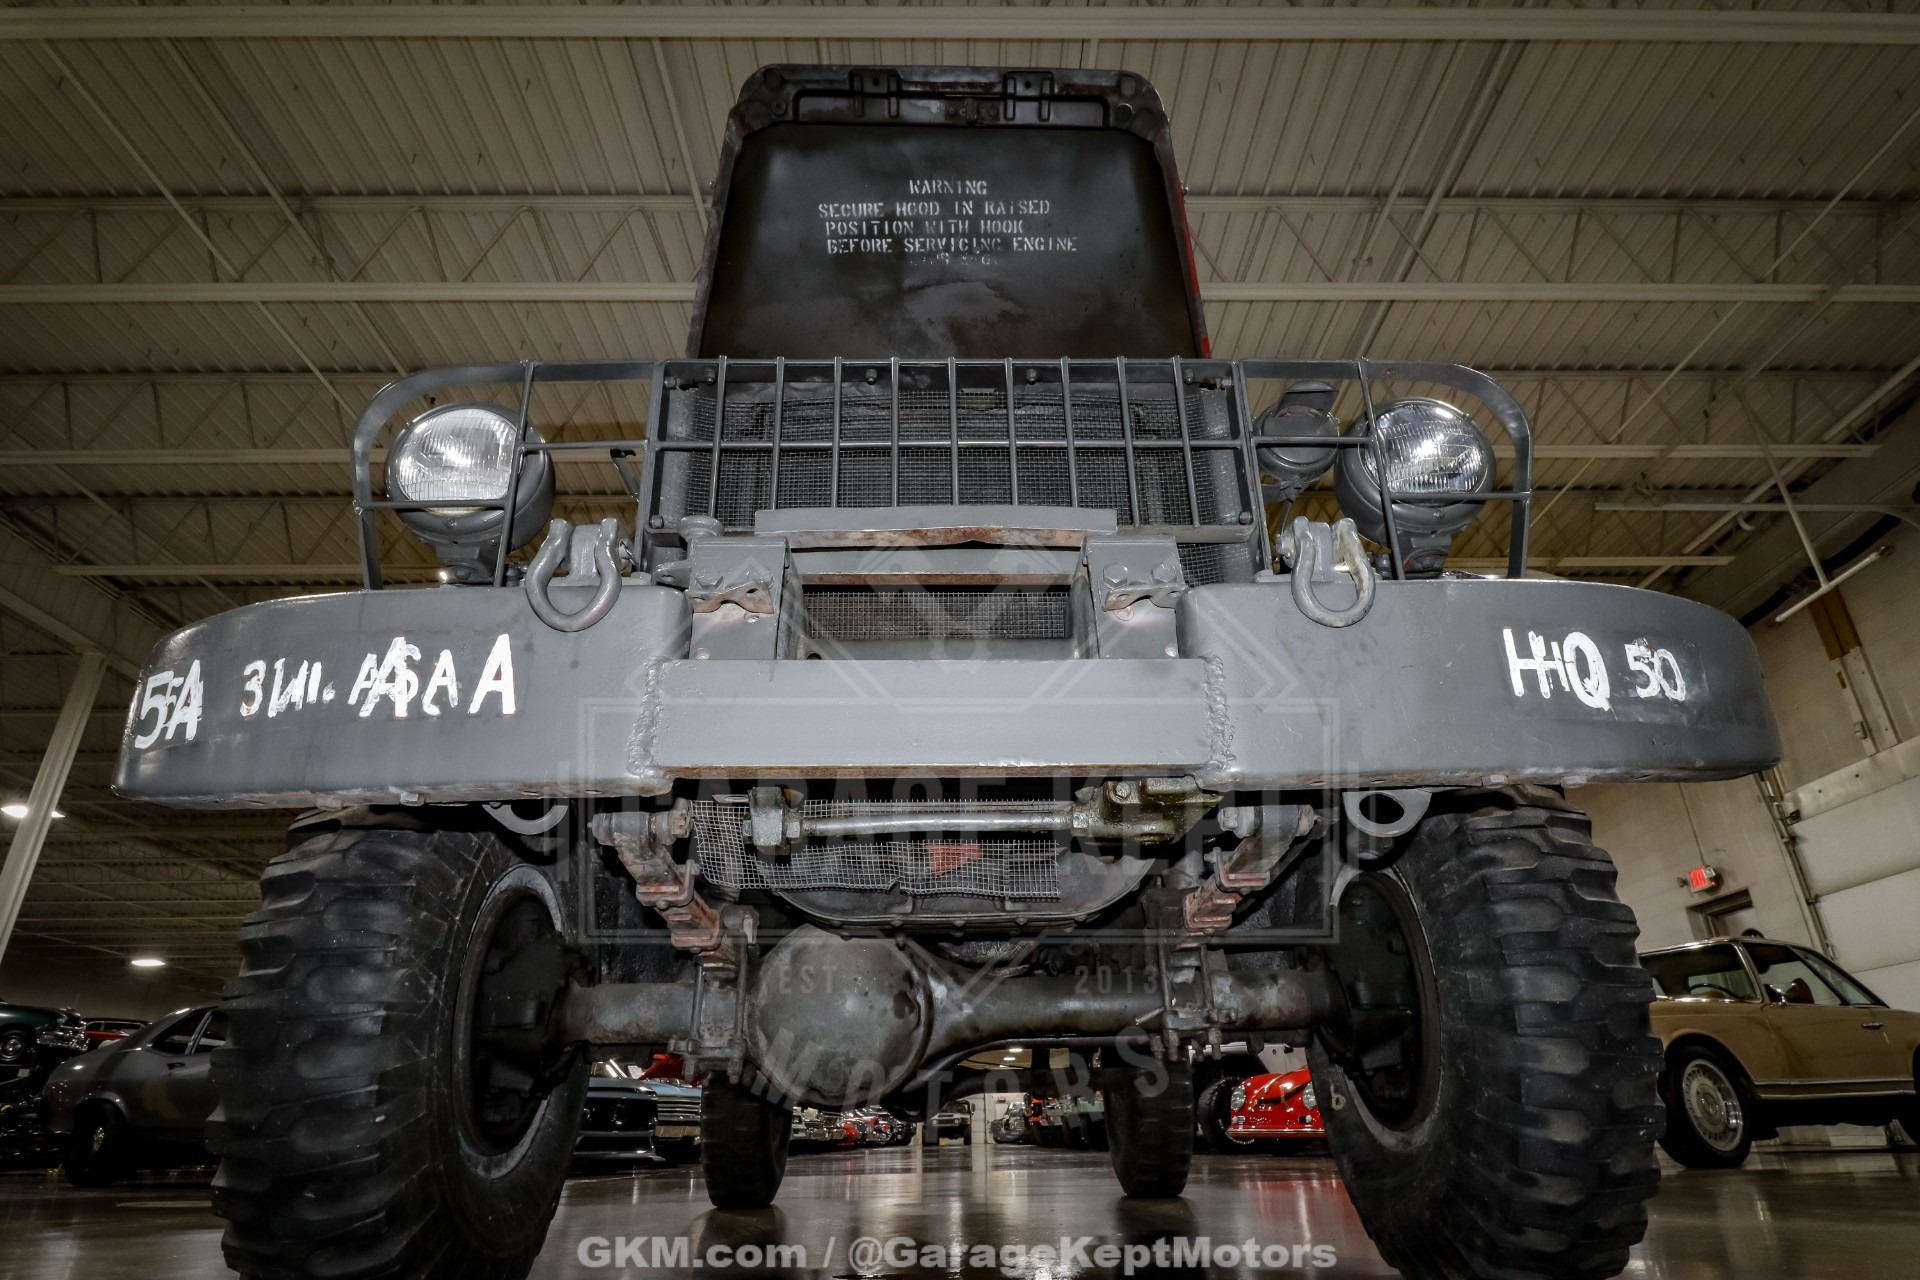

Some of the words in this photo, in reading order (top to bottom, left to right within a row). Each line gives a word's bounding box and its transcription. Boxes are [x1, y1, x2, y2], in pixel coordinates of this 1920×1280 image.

[909, 179, 987, 195] WARNING
[818, 202, 884, 218] SECURE
[895, 201, 940, 217] HOOD
[954, 201, 973, 216] IN
[984, 200, 1050, 215] RAISED
[825, 220, 914, 236] POSITION
[925, 219, 969, 235] WITH
[980, 219, 1024, 235] HOOK
[827, 238, 893, 254] BEFORE
[903, 237, 1001, 253] SERVICING
[1012, 236, 1077, 252] ENGINE
